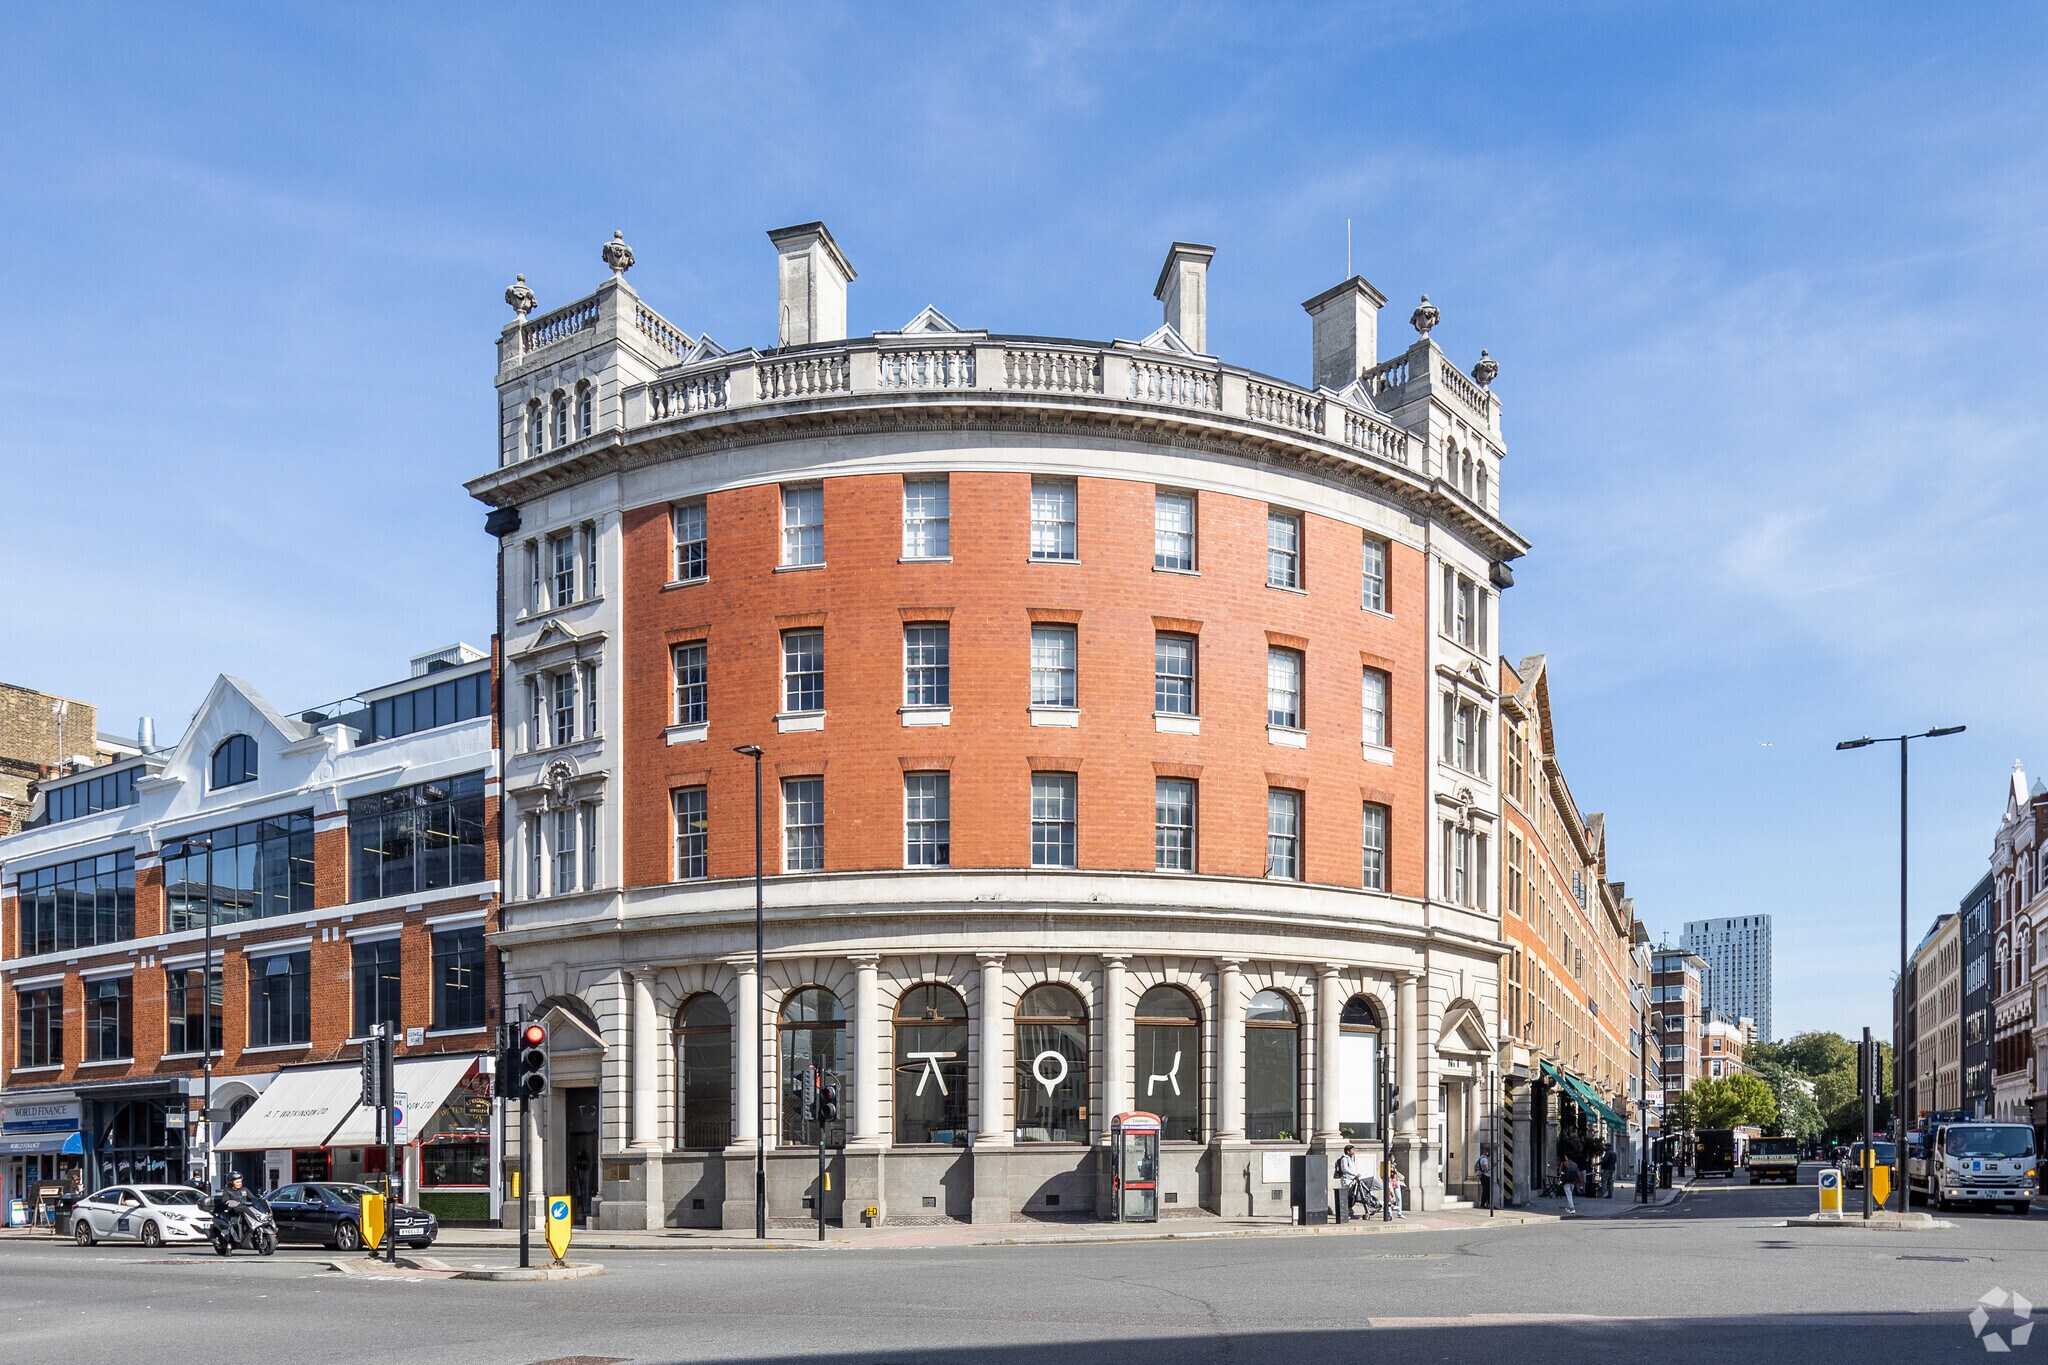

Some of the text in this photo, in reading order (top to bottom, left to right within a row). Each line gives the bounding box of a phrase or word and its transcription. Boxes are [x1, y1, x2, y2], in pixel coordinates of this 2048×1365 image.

[15, 1105, 67, 1117] WORLD FINANCE
[264, 1110, 272, 1118] A
[273, 1110, 280, 1118] T
[280, 1110, 316, 1118] WATKINSON
